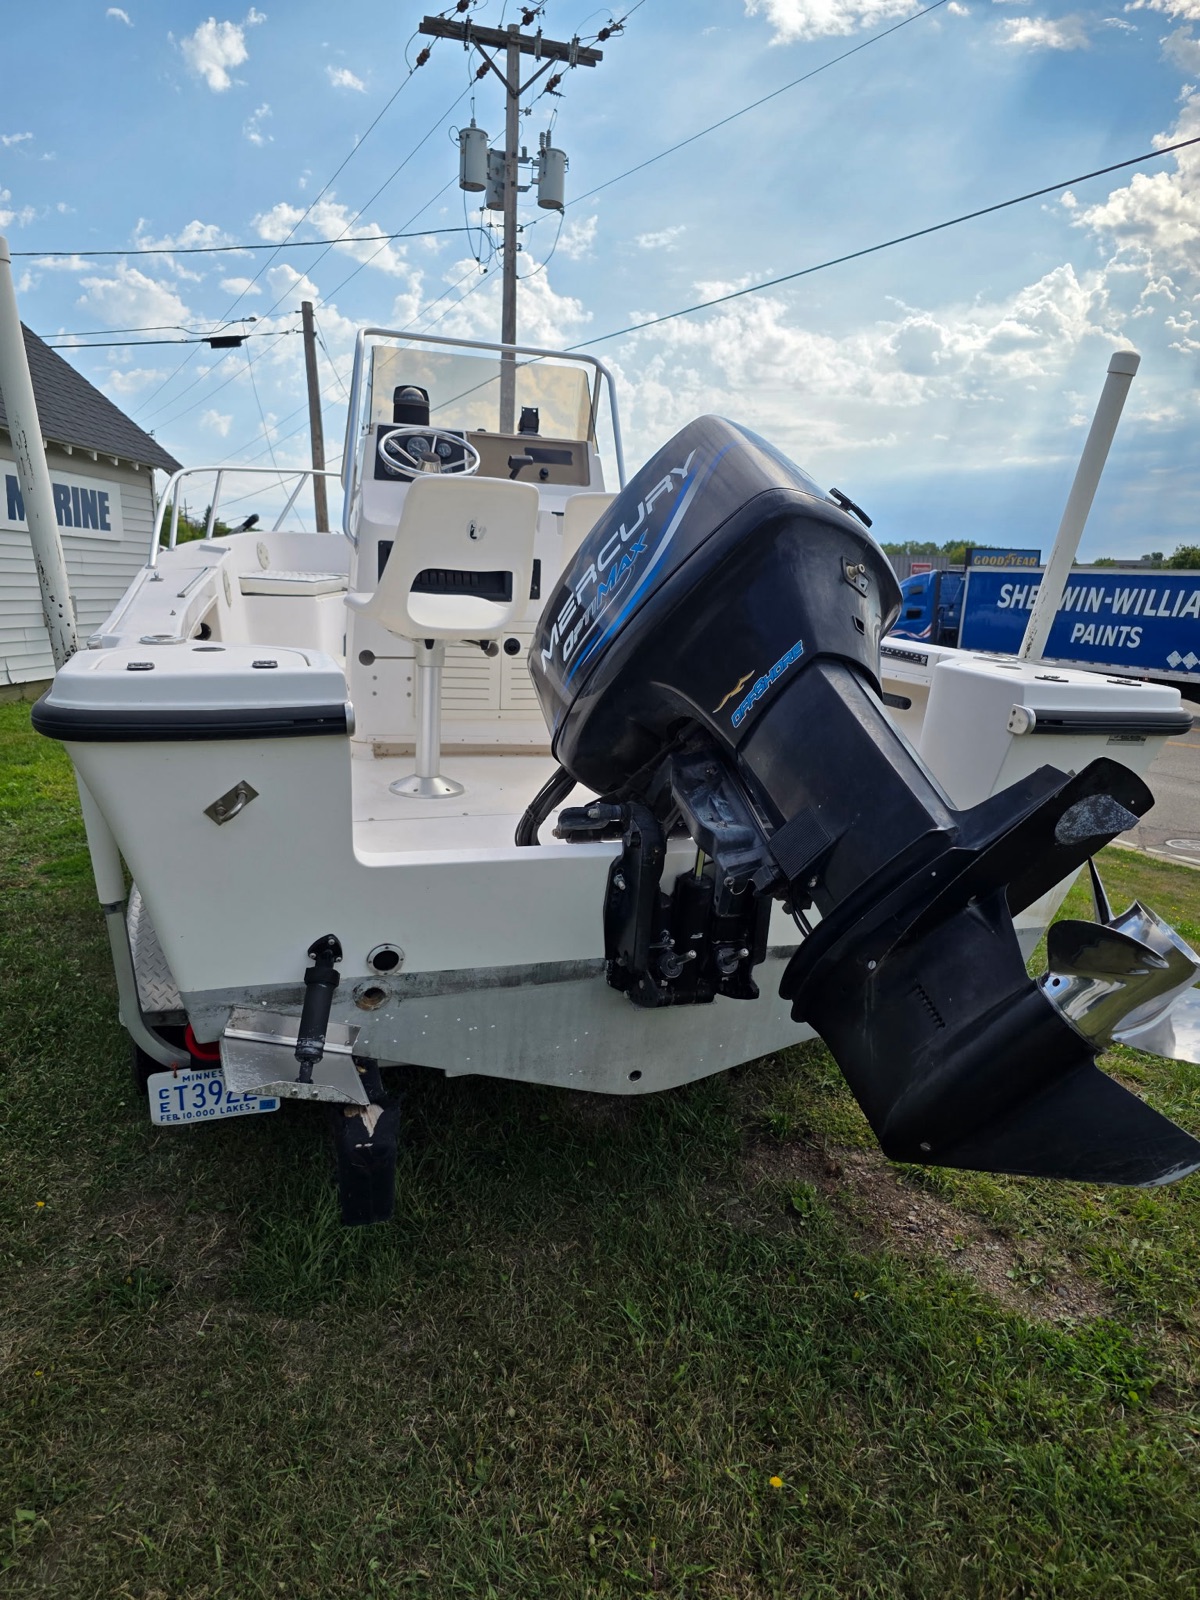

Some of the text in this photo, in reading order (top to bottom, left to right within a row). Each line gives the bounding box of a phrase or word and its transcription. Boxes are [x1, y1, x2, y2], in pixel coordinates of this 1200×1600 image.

[5, 474, 111, 531] MRINE
[540, 448, 697, 673] MERCURY
[974, 553, 1037, 566] GOODYEAR
[997, 583, 1200, 618] SHEWIN-WILLIA
[1070, 623, 1143, 648] PAINTS
[731, 639, 803, 728] OFFSHORE
[182, 1070, 224, 1082] MINNES
[220, 1103, 250, 1114] LAKES
